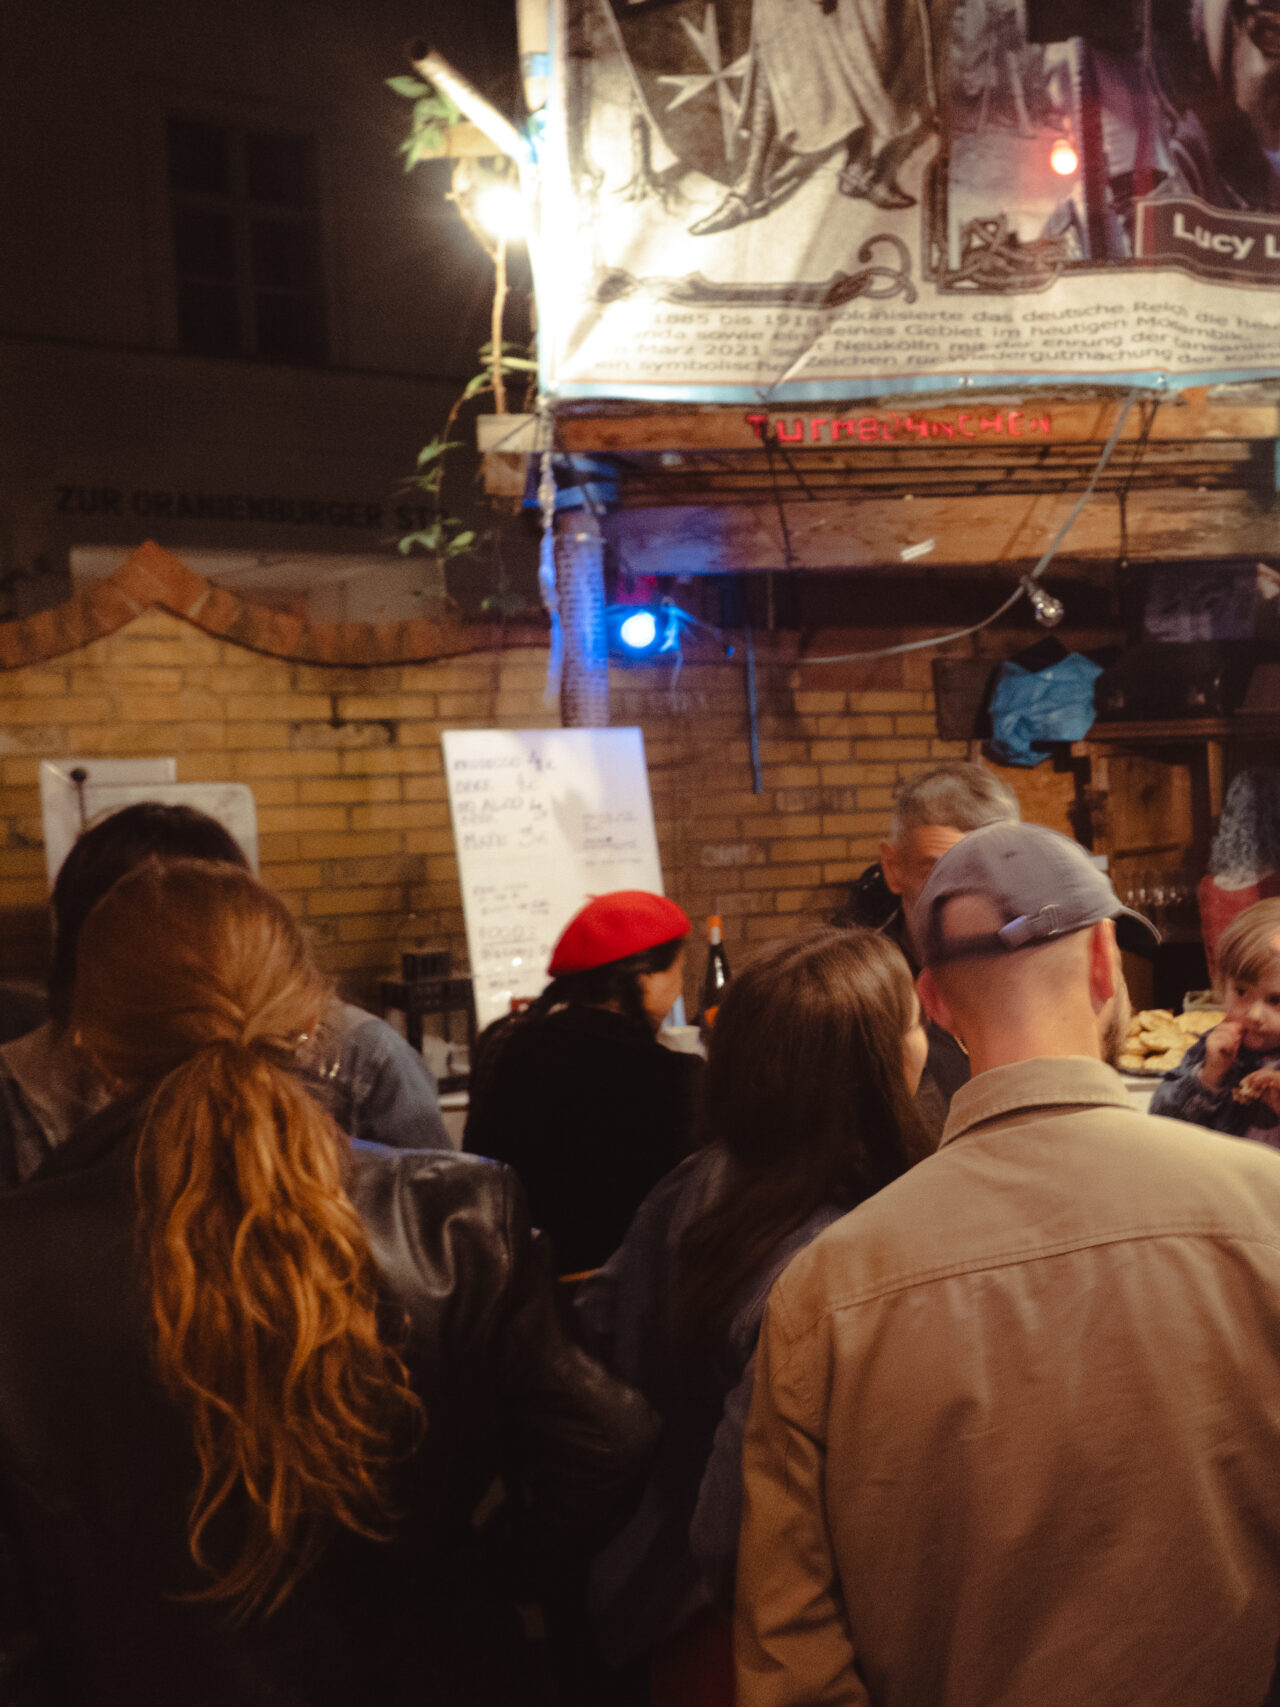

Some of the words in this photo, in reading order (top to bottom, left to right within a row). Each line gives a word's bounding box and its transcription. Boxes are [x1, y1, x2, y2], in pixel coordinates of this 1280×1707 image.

[1172, 212, 1254, 259] Lucy
[828, 309, 965, 323] olonisierte
[971, 311, 1014, 323] das
[1021, 301, 1126, 322] deutsche
[1195, 313, 1229, 328] die
[904, 323, 982, 338] Gebiet
[992, 325, 1022, 339] im
[1030, 315, 1128, 336] heutigen
[55, 483, 123, 516] ZUR
